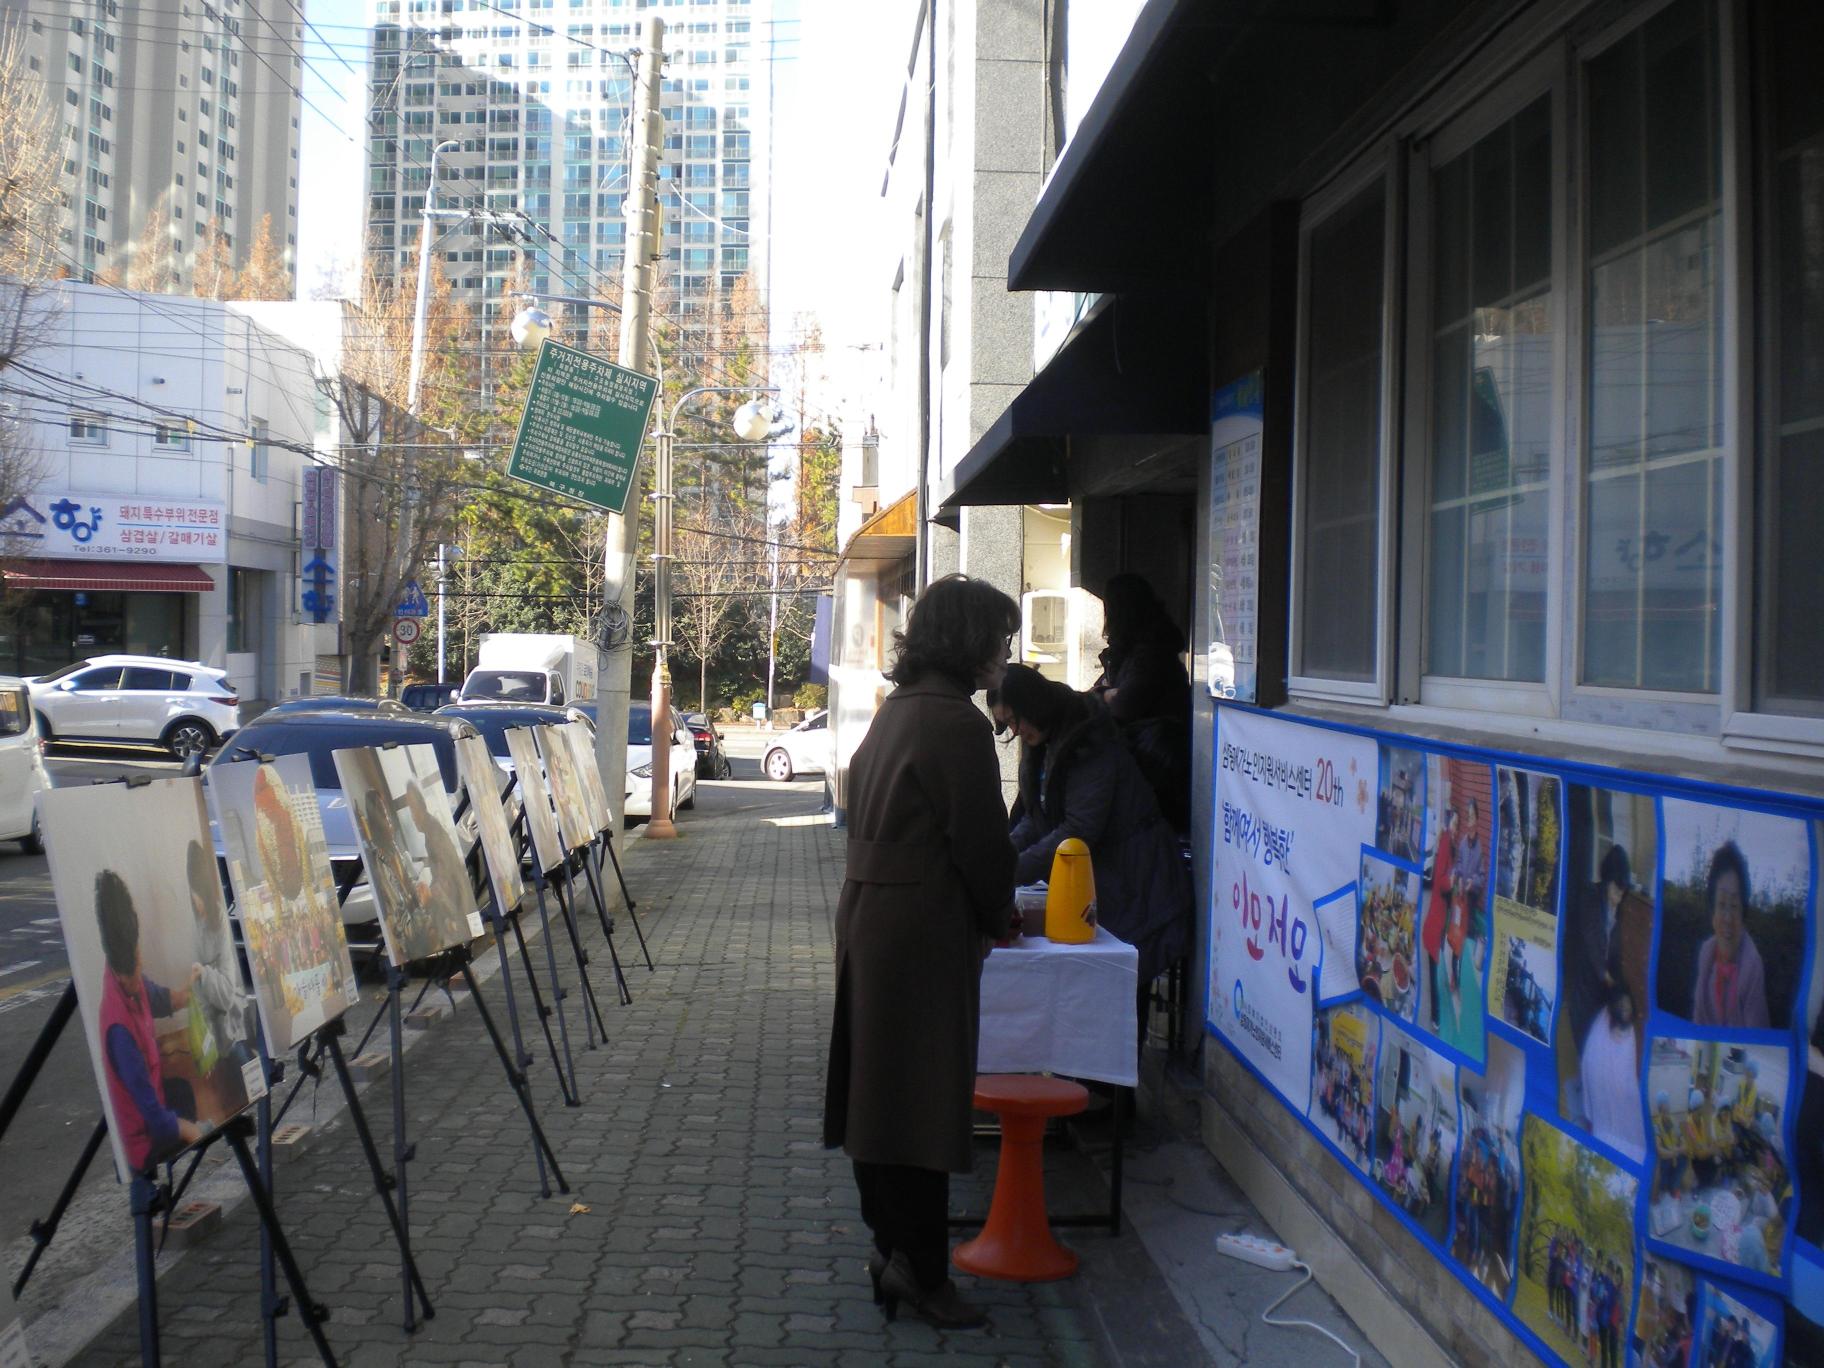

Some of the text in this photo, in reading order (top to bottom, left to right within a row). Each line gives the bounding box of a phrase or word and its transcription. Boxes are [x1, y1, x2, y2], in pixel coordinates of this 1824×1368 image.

[548, 347, 612, 379] 주거지전용주차제
[614, 371, 647, 392] 실시지역
[400, 625, 412, 636] 30
[1317, 758, 1344, 808] 20th
